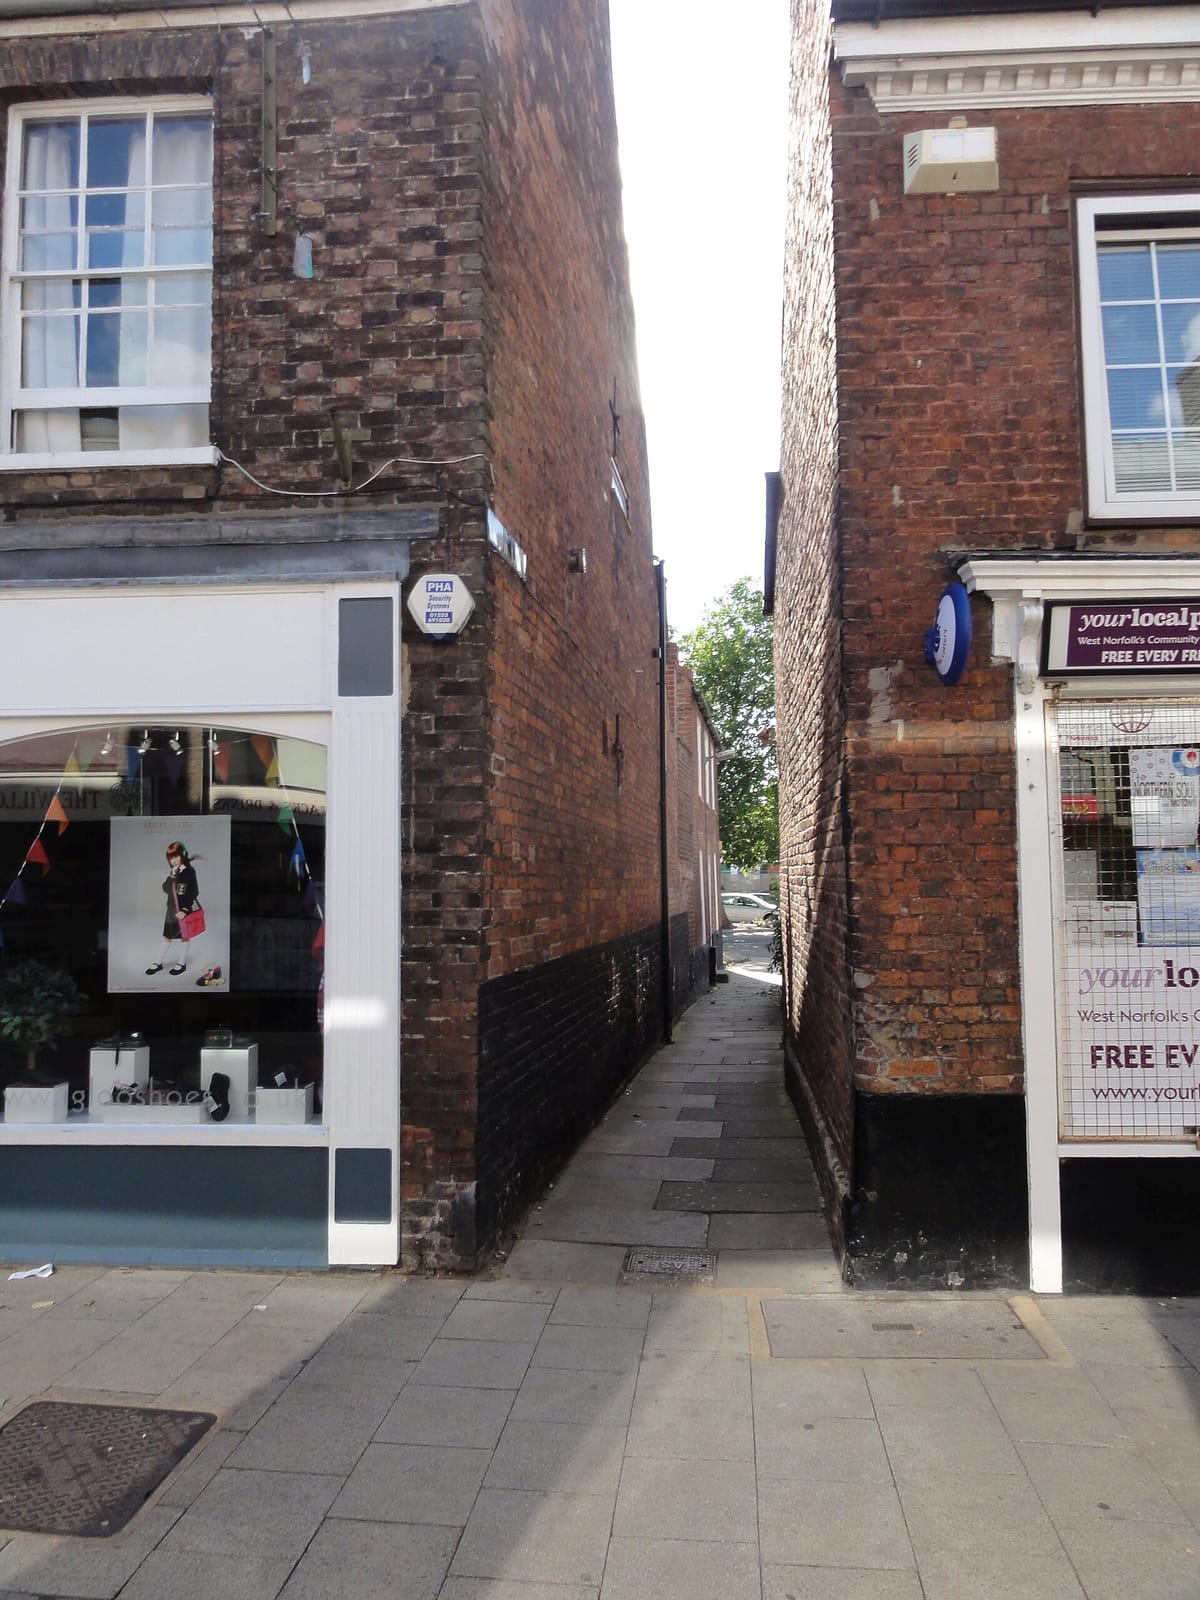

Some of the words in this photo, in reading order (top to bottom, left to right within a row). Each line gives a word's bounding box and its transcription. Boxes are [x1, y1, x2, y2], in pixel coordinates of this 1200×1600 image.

[428, 582, 452, 592] PHA
[1078, 636, 1101, 645] West
[1103, 635, 1145, 645] Norfolk's
[1147, 634, 1200, 645] Community
[1101, 650, 1133, 663] FREE
[1136, 649, 1179, 663] EVERY
[1077, 1009, 1115, 1023] West
[1090, 1044, 1155, 1069] FREE
[1165, 1043, 1199, 1068] EV
